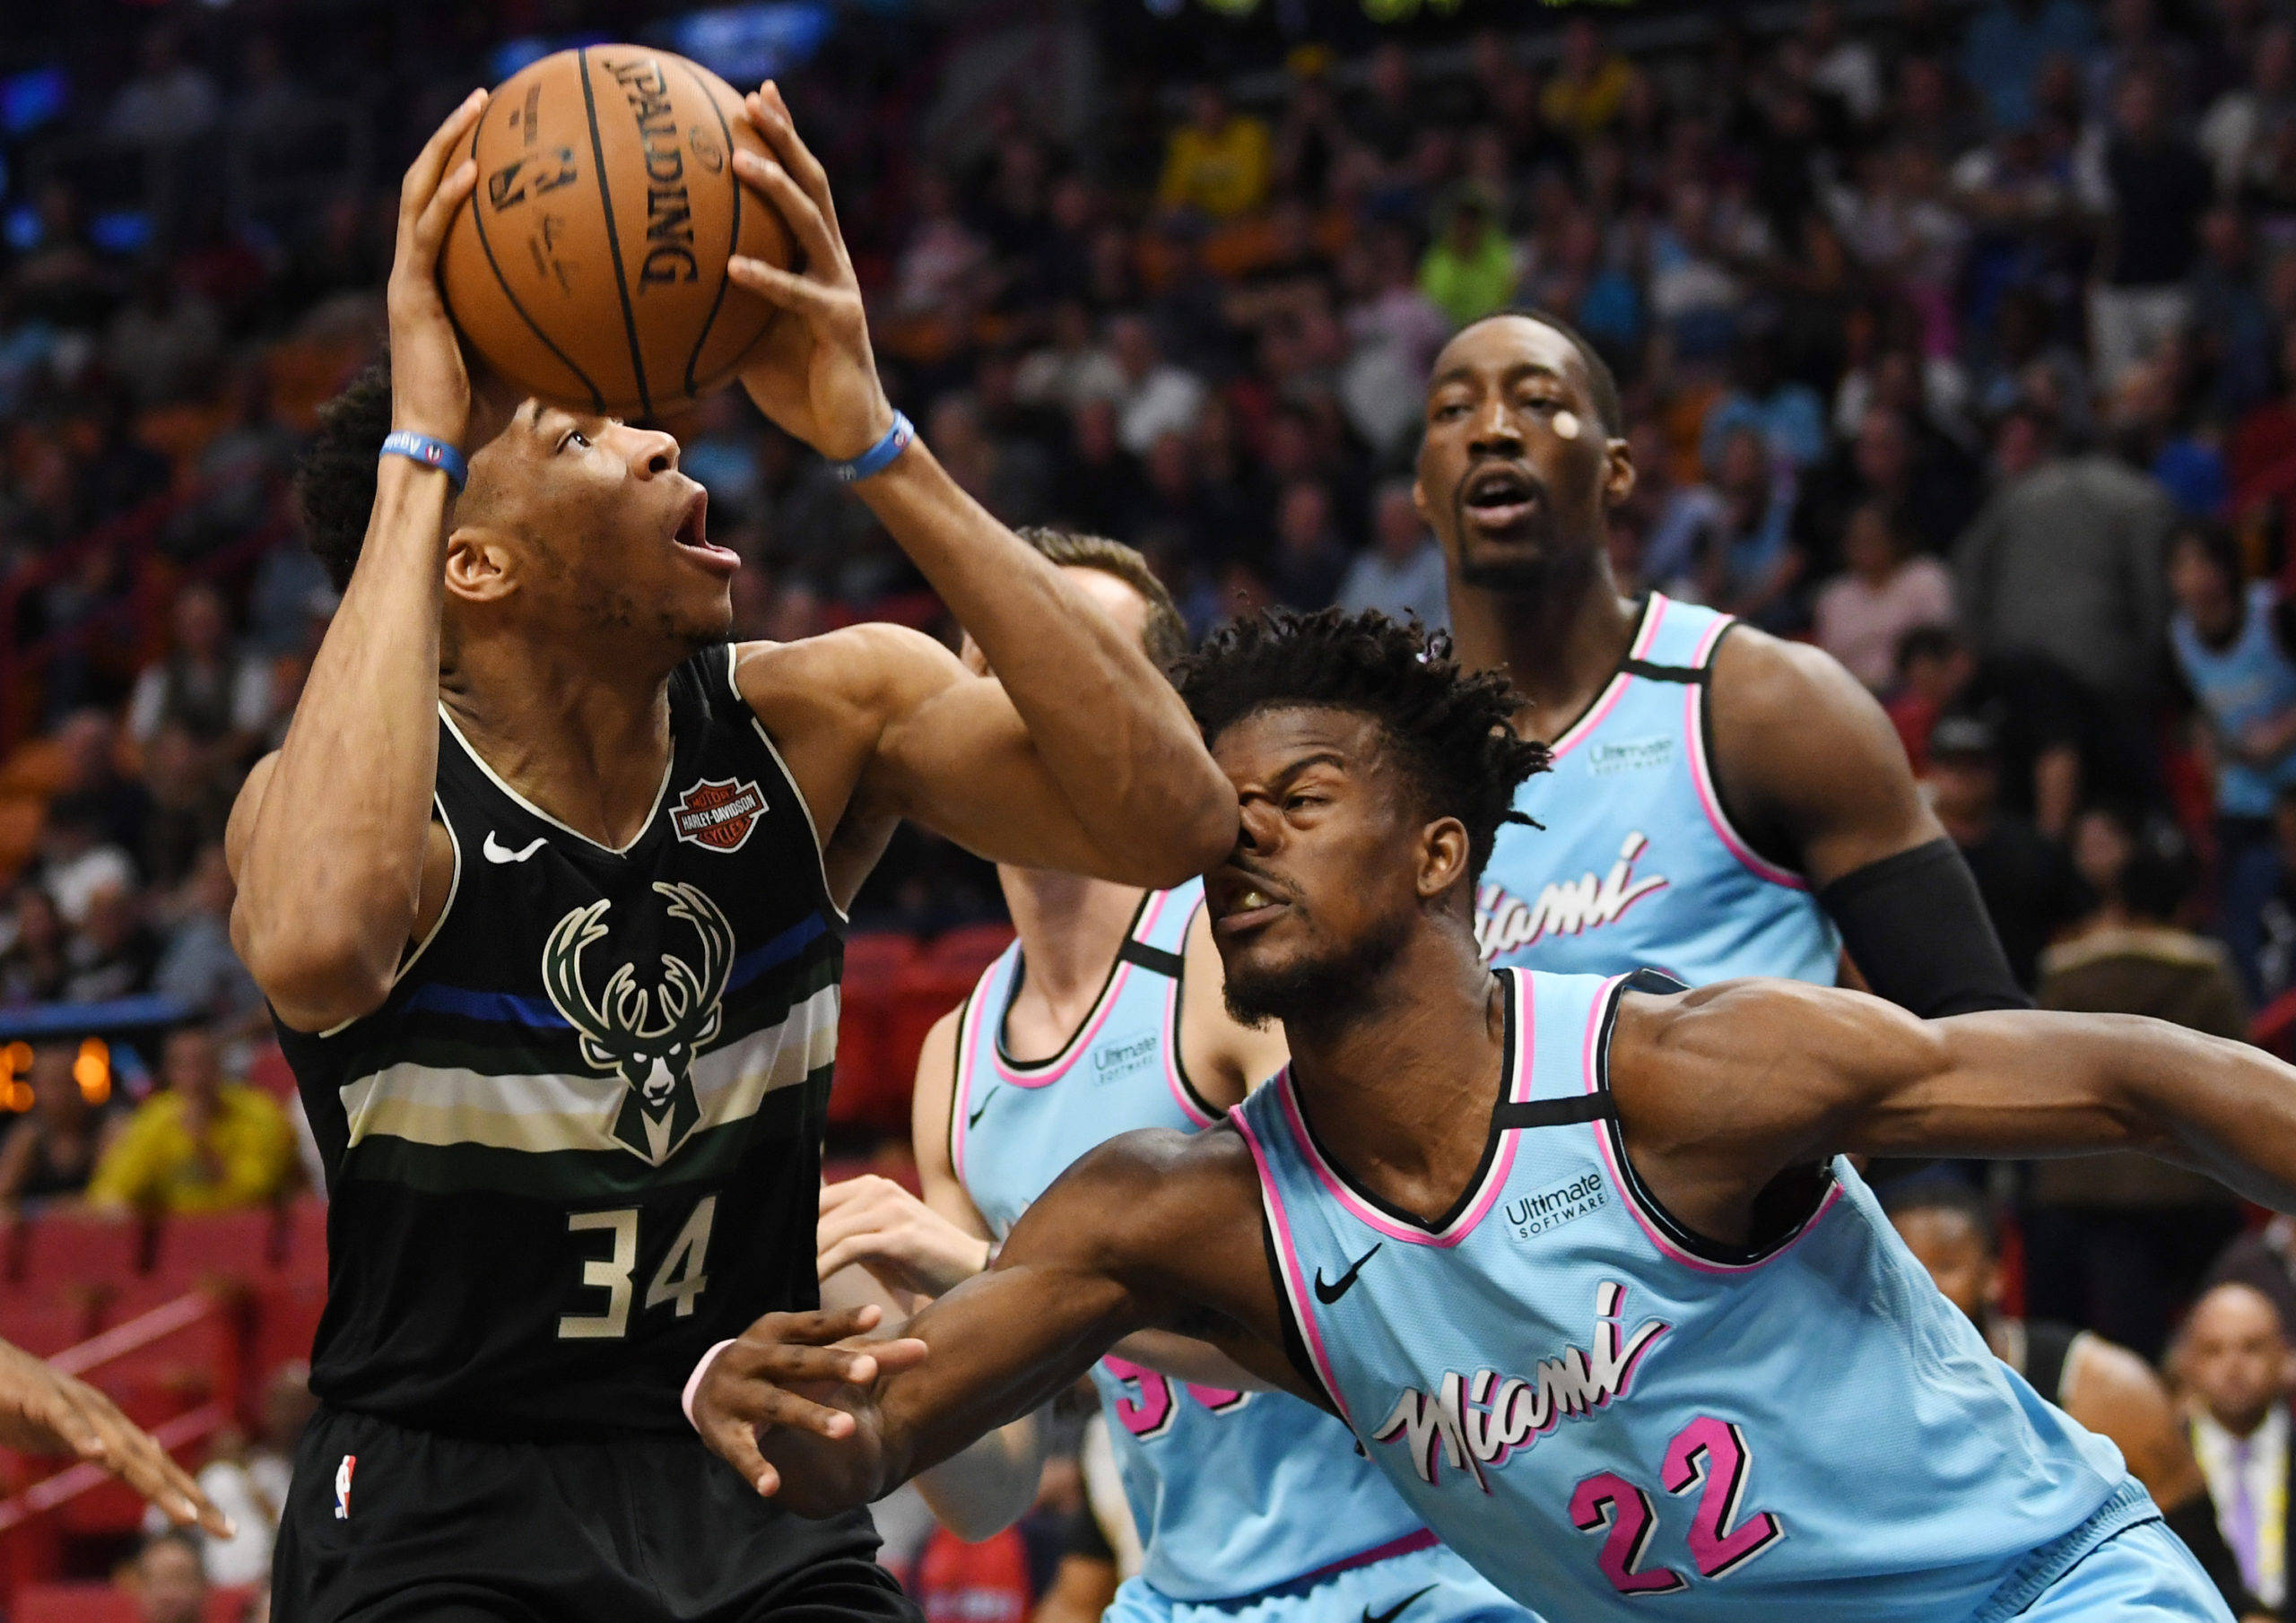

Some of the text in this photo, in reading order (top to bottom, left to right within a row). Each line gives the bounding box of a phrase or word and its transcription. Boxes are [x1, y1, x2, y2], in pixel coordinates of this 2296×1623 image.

[602, 56, 699, 297] SPALDING
[682, 794, 756, 831] HARLEY-DAVIDSON
[1474, 830, 1669, 961] iami
[557, 1194, 718, 1339] 34
[1506, 1174, 1601, 1226] Ultimate
[1519, 1193, 1605, 1238] SOFTWARE
[1372, 1280, 1671, 1497] Miami
[1568, 1416, 1785, 1596] 22
